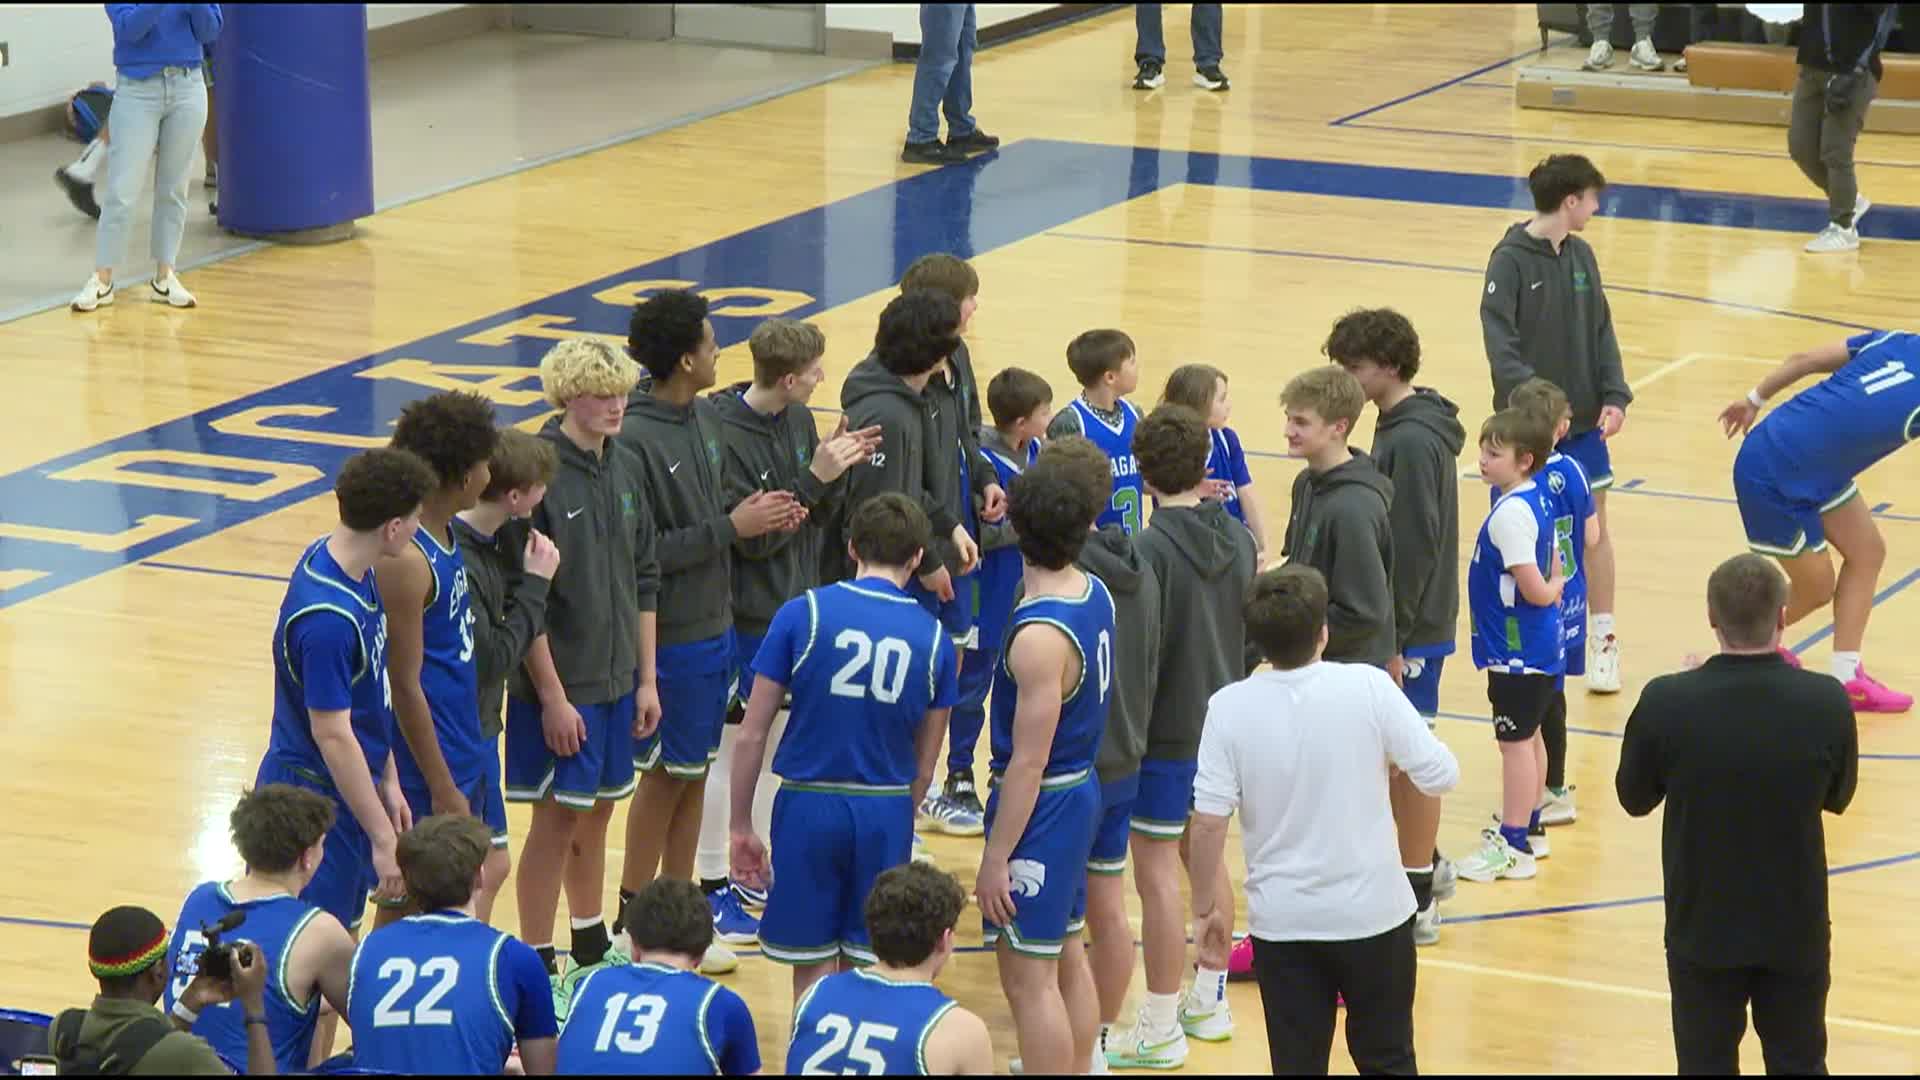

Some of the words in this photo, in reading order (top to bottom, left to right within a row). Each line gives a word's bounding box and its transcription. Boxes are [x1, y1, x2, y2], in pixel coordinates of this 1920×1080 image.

[1860, 360, 1915, 396] 11
[0, 279, 816, 592] LDCATS
[871, 451, 886, 467] 12
[1111, 485, 1141, 541] 3
[830, 628, 912, 704] 20
[373, 955, 460, 1028] 22
[594, 991, 669, 1055] 13
[801, 1012, 898, 1076] 25
